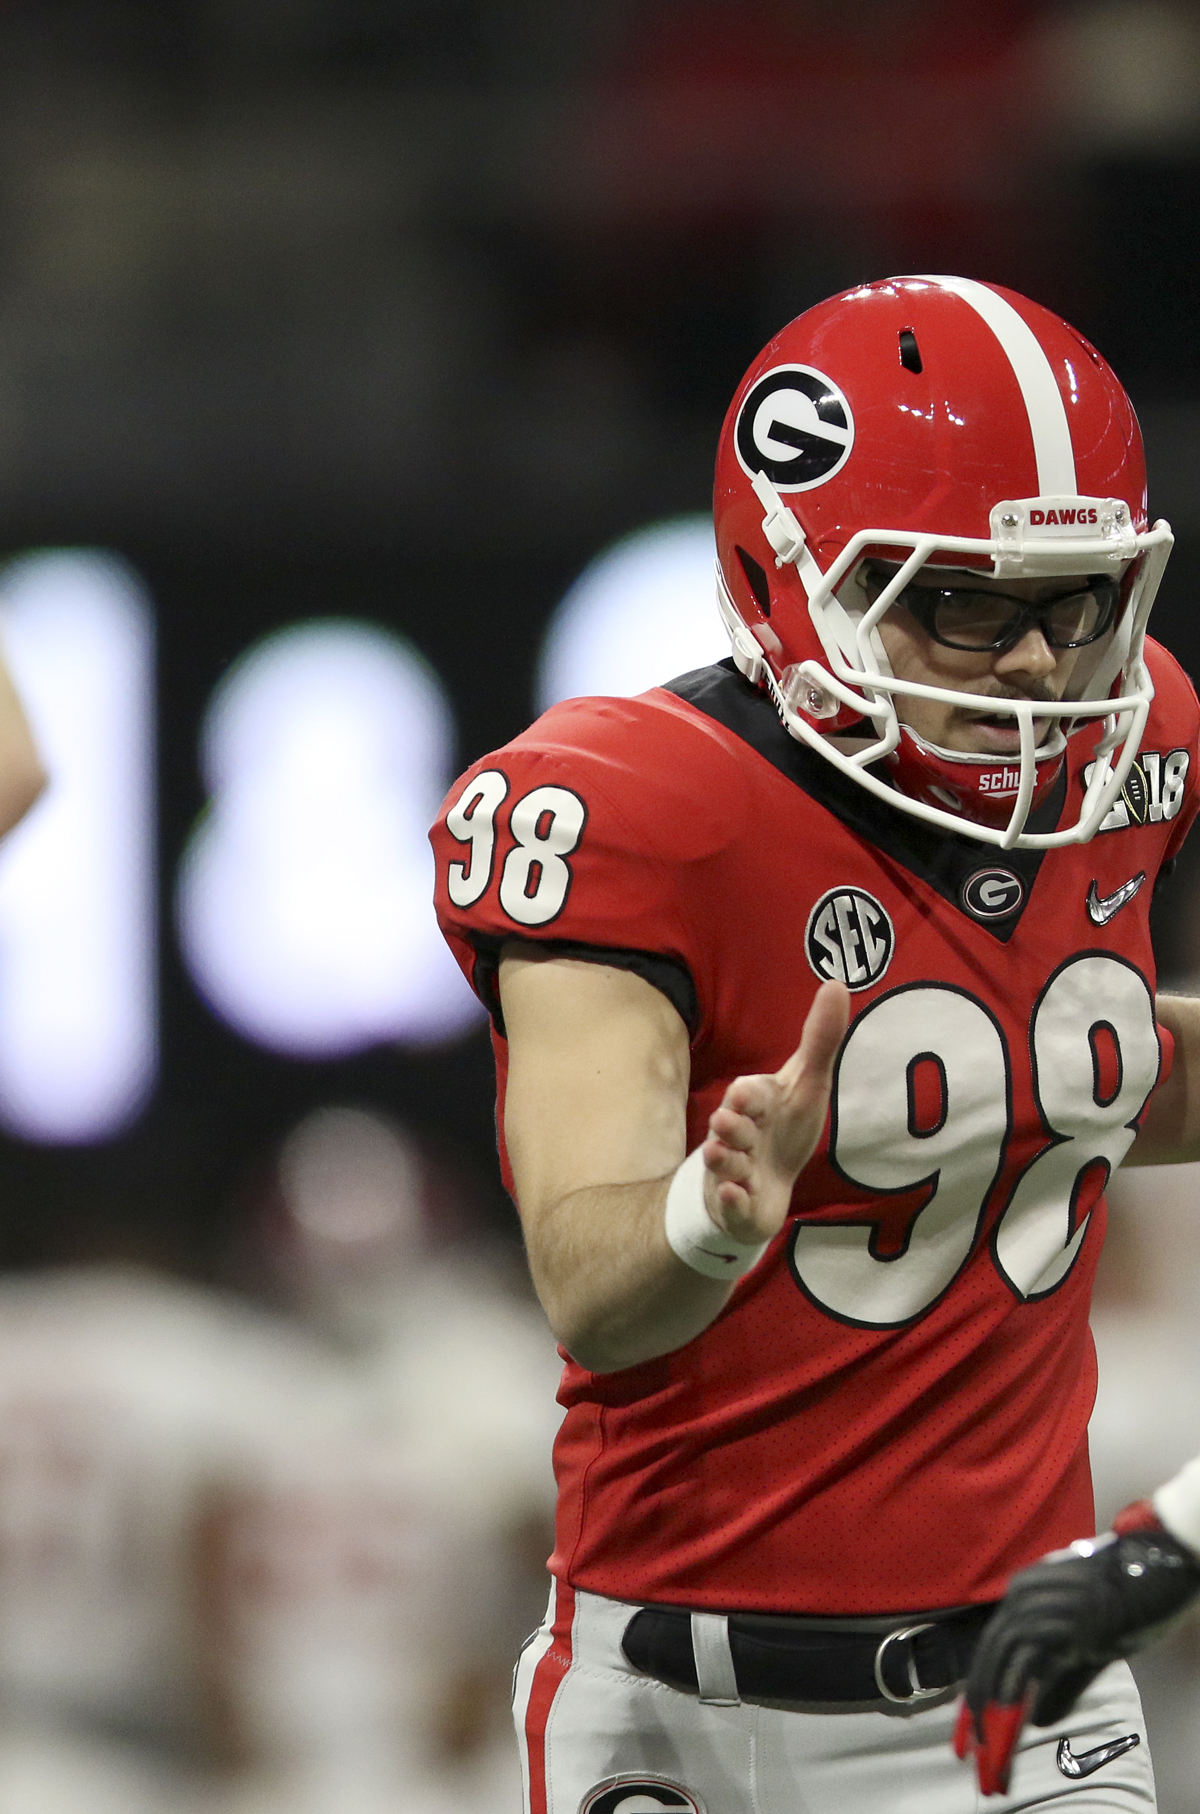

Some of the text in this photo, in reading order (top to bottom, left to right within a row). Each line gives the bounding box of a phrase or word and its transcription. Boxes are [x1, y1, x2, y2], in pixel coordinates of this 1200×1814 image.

[737, 369, 850, 487] G
[1029, 508, 1098, 526] DAWGS
[445, 770, 589, 926] 98
[965, 870, 1022, 915] G
[813, 895, 886, 983] SEC
[788, 950, 1160, 1329] 98
